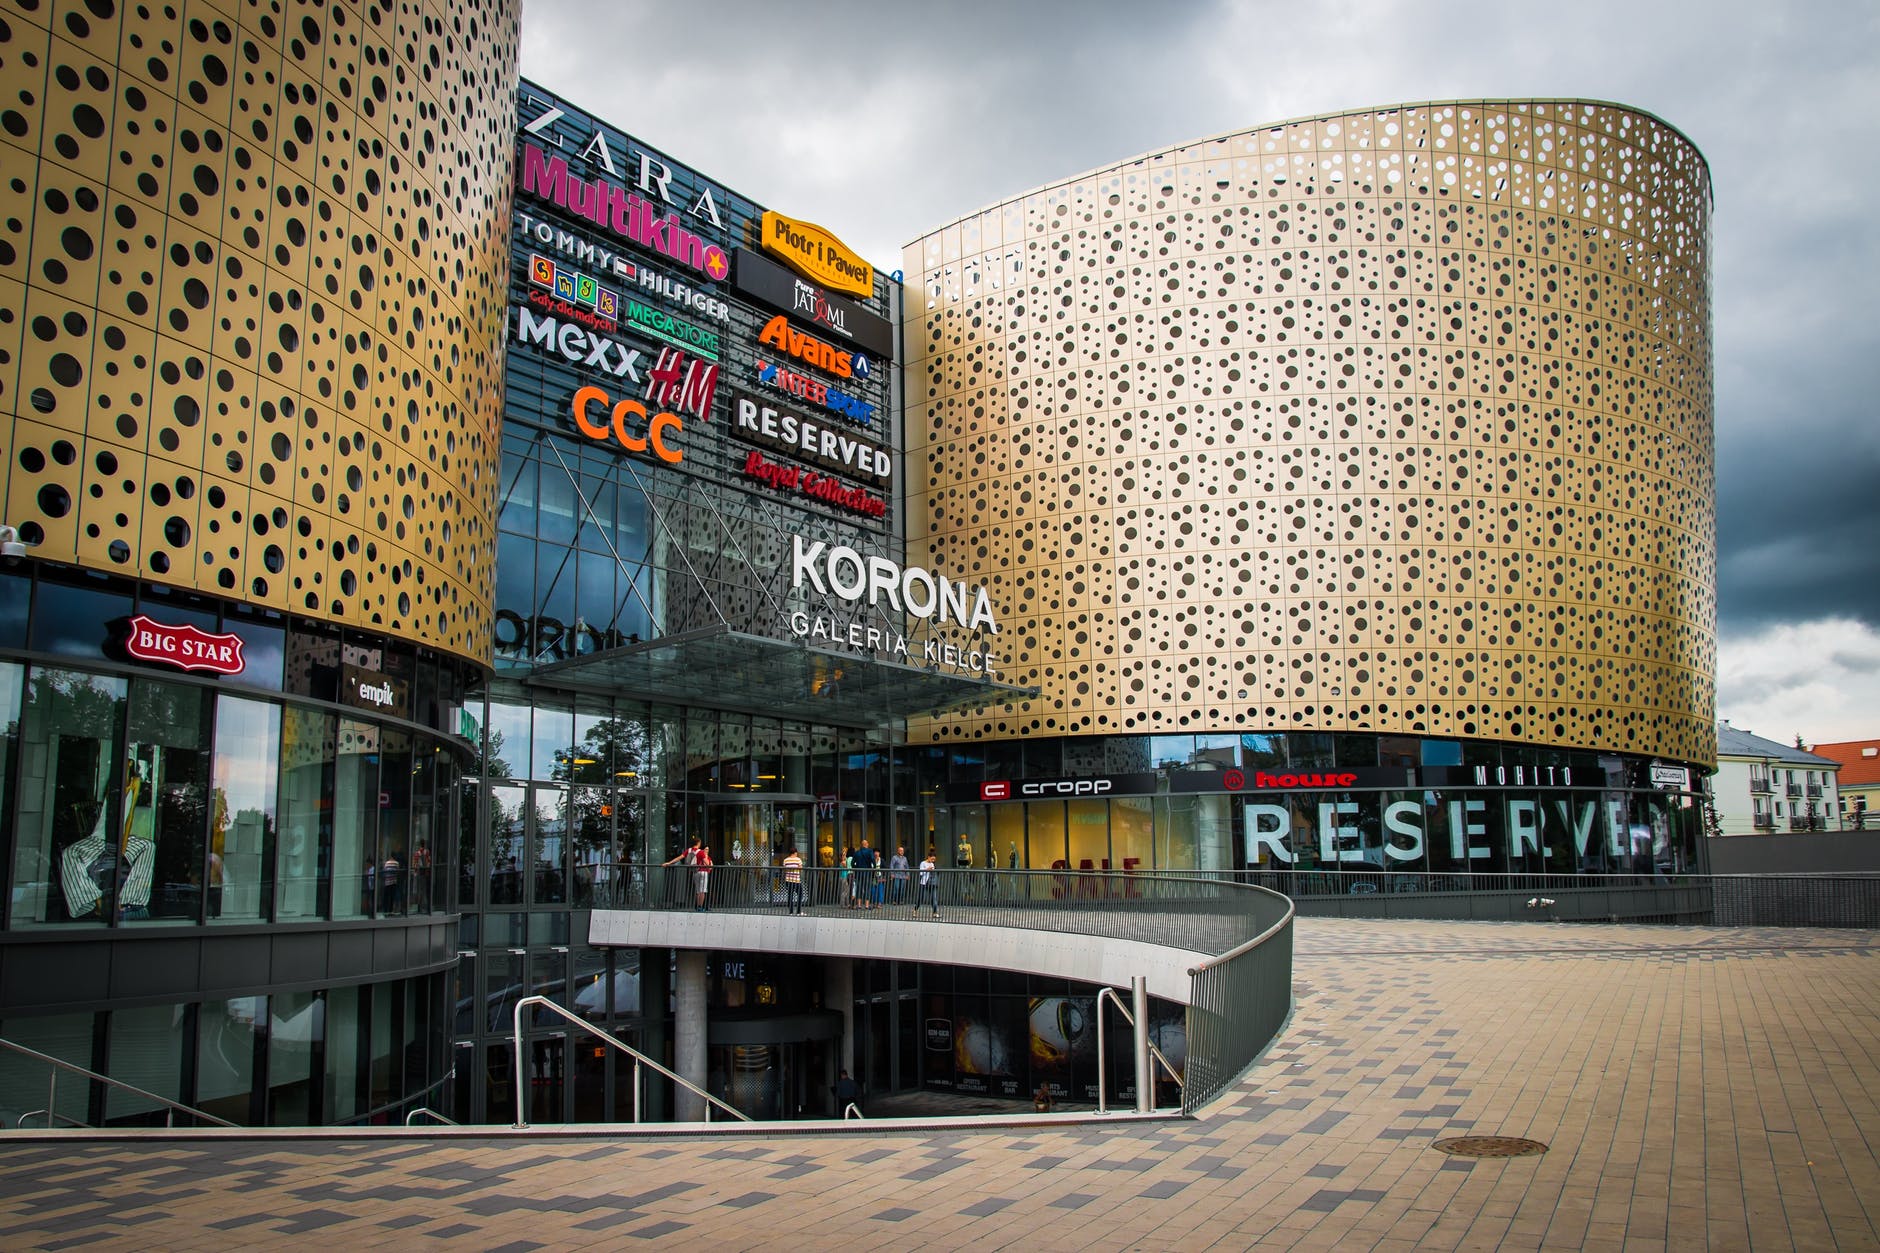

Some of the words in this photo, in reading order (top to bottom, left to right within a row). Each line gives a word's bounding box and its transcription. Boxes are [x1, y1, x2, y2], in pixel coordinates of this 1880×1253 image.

[523, 94, 728, 231] ZARA
[519, 213, 612, 270] TOMMY
[639, 271, 730, 323] HILFIGER
[775, 219, 814, 255] Piotr
[817, 241, 823, 262] i
[827, 247, 869, 285] Paweł
[556, 302, 574, 318] dla
[794, 279, 814, 295] Pure
[628, 300, 719, 353] MEGASTORE
[758, 315, 852, 379] Avans
[645, 346, 720, 423] H&M
[776, 364, 876, 425] INTERSPORT
[571, 386, 683, 464] CCC
[738, 398, 892, 478] RESERVED
[744, 450, 800, 489] Royal
[791, 534, 998, 636] KORONA
[139, 630, 176, 652] BIG
[181, 639, 233, 663] STAR
[790, 611, 908, 657] GALERIA
[924, 639, 997, 674] KIELCE
[359, 681, 394, 707] empik
[1021, 778, 1112, 796] cropp
[1255, 770, 1359, 788] house
[1474, 764, 1573, 787] MOHITO
